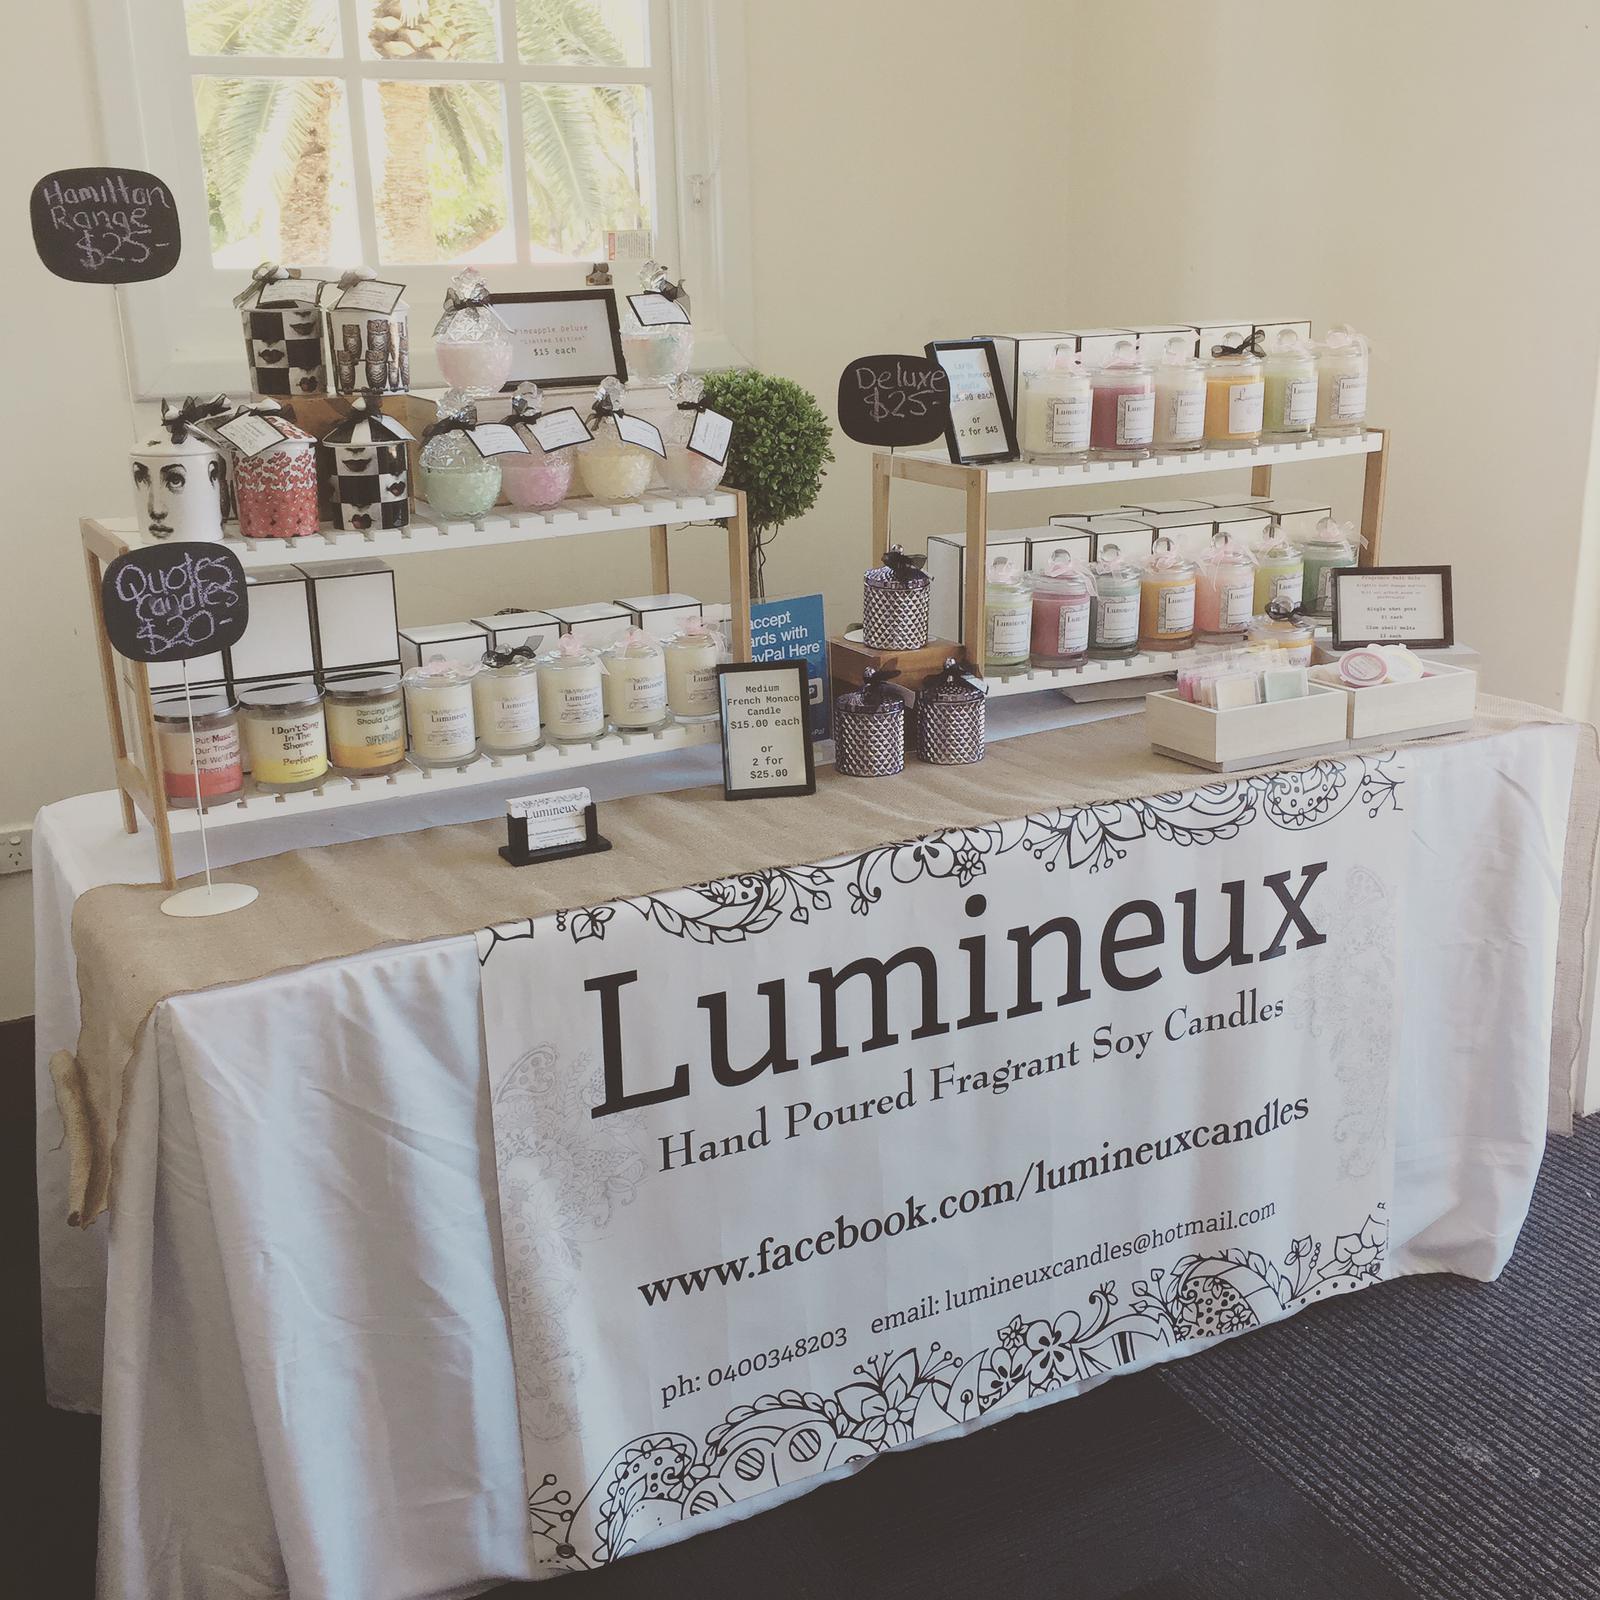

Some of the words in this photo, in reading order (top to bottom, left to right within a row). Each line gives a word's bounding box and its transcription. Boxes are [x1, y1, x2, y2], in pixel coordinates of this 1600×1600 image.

[43, 175, 170, 208] Hamilton
[50, 205, 152, 236] Range
[560, 324, 589, 334] Deluxe
[533, 347, 550, 357] $15
[555, 346, 577, 355] each
[855, 361, 948, 393] Deluxe
[976, 392, 995, 400] each
[972, 416, 981, 424] or
[959, 429, 966, 437] 2
[968, 425, 982, 436] for
[984, 425, 999, 435] $45
[115, 552, 236, 603] Quotes
[781, 625, 809, 641] with
[745, 685, 780, 693] Medium
[727, 696, 761, 706] French
[765, 694, 800, 704] Monaco
[747, 706, 782, 716] Candle
[356, 716, 383, 726] Should
[730, 719, 769, 730] $15.00
[774, 717, 800, 727] each
[271, 727, 275, 735] I
[277, 724, 302, 735] Don't
[195, 737, 210, 745] Put
[283, 734, 295, 742] In
[295, 731, 311, 741] The
[282, 739, 314, 751] Shower
[760, 744, 774, 753] or
[282, 753, 319, 767] Perform
[752, 758, 759, 767] 2
[765, 756, 784, 766] for
[750, 768, 788, 780] $25.00
[525, 804, 579, 820] Lumineux
[584, 861, 1328, 1119] Lumineux
[658, 1105, 770, 1172] Hand
[784, 1068, 917, 1139] Poured
[929, 1041, 1080, 1101] Fragrant
[1092, 1023, 1153, 1063] Soy
[1164, 988, 1284, 1042] Candles
[637, 1097, 1309, 1306] www.facebook.com/lumineuxcandles
[661, 1373, 701, 1409] ph:
[707, 1327, 848, 1387] 0400348203
[871, 1297, 940, 1334] email:
[945, 1201, 1276, 1312] lumineuxcandles@hotmail.com
